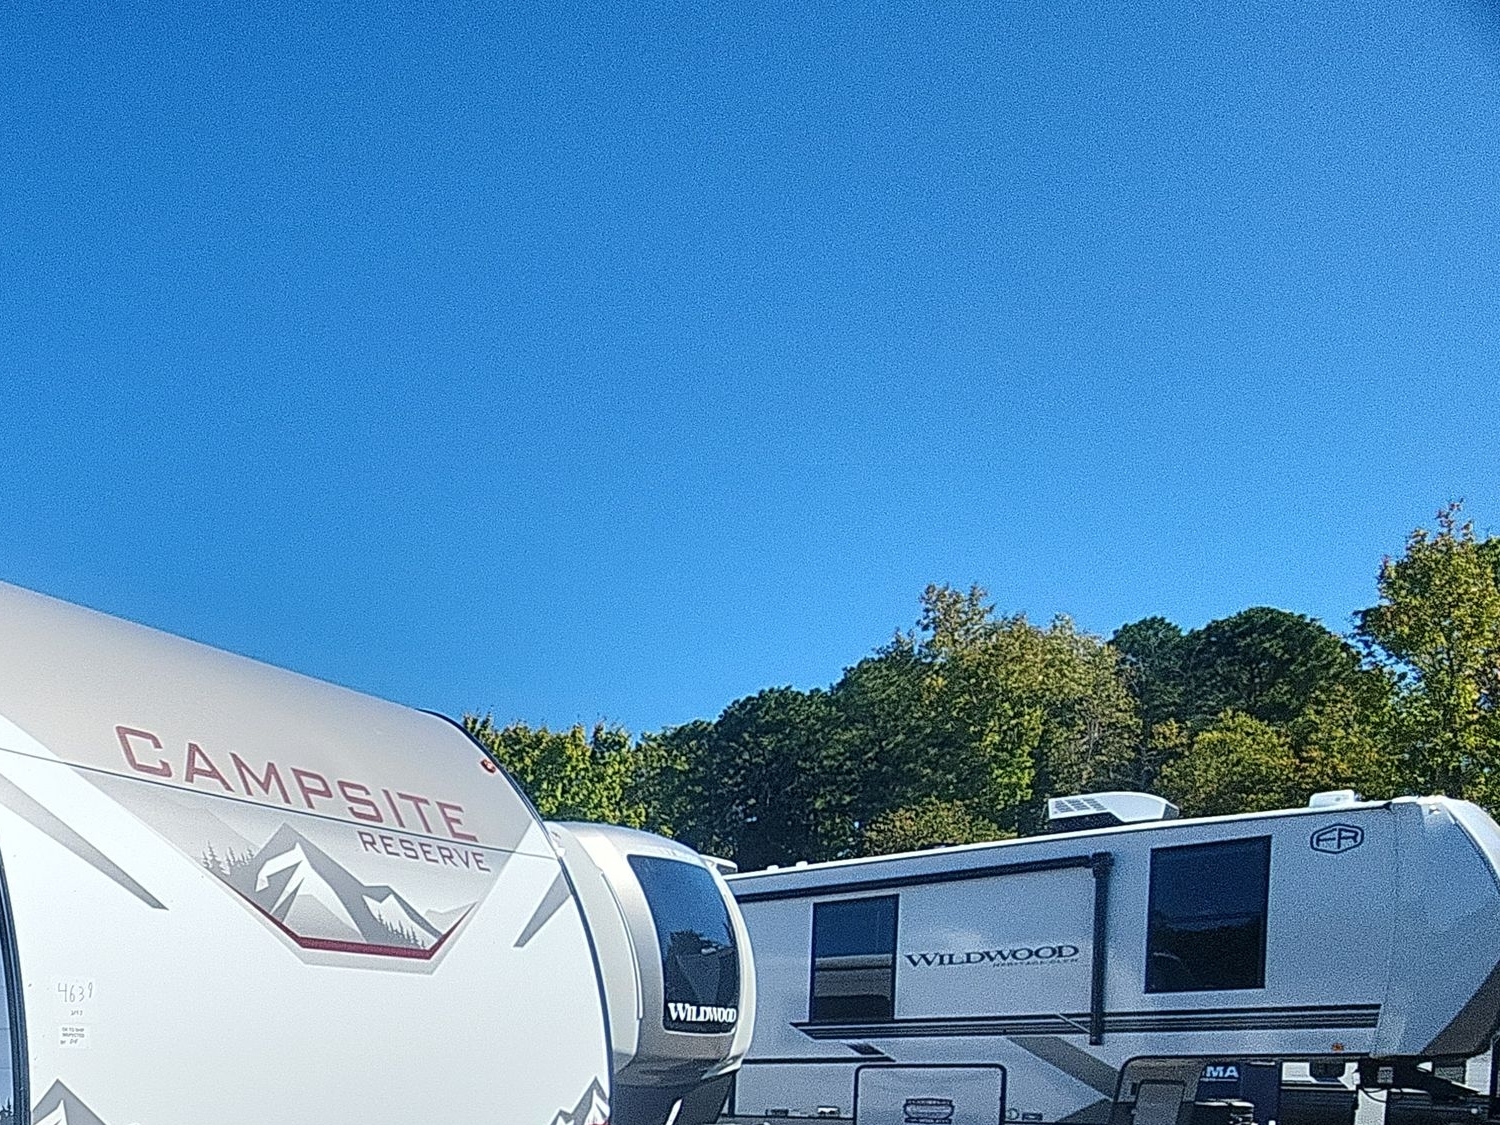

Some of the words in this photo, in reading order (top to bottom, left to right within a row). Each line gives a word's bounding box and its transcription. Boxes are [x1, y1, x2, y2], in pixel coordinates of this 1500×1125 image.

[115, 725, 479, 842] CAMPSITE
[358, 831, 490, 872] RESERVE
[904, 945, 1079, 967] WILDWOOD
[1202, 1066, 1239, 1078] MA
